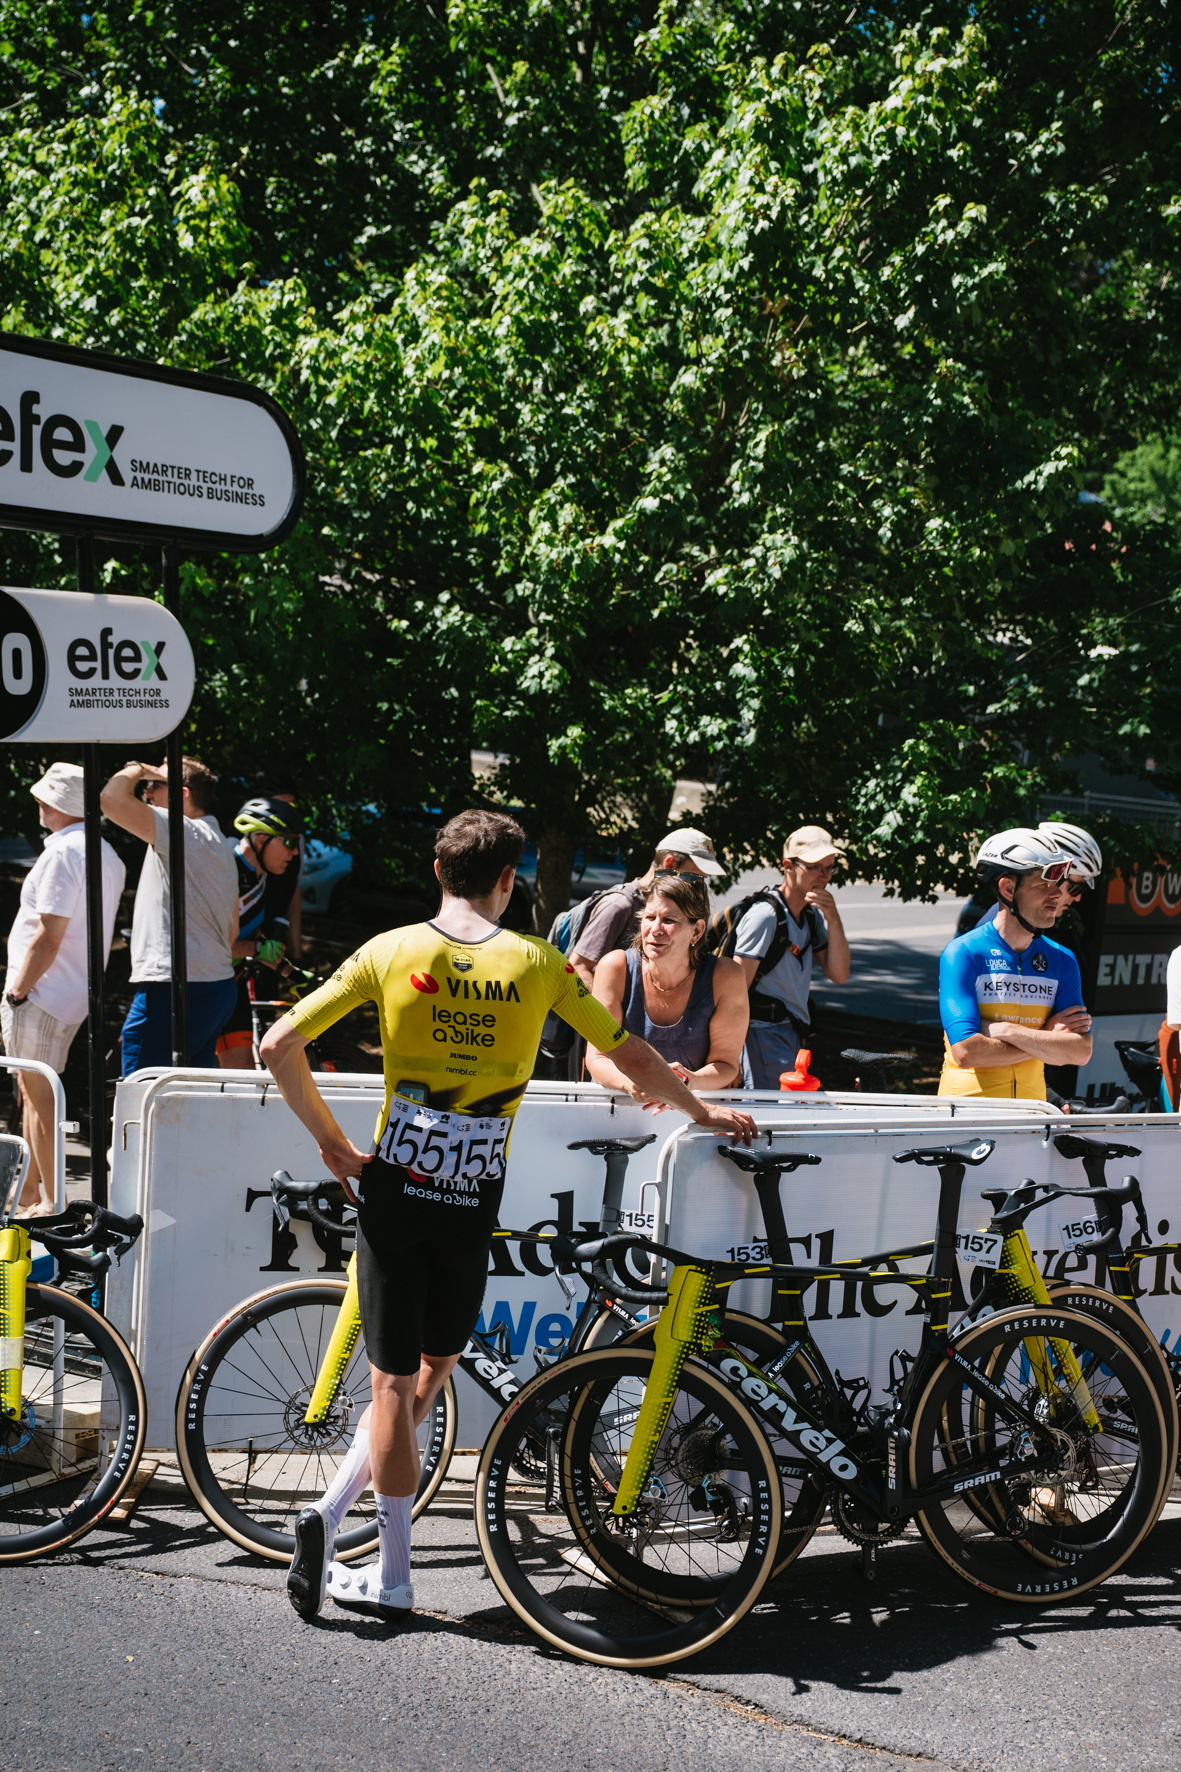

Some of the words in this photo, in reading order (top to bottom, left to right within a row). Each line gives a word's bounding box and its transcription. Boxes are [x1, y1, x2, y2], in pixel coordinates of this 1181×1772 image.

[130, 459, 192, 481] SMARTER
[195, 469, 227, 486] TECH
[230, 475, 254, 490] FOR
[130, 476, 203, 498] AMBITIOUS
[206, 487, 265, 507] BUSINESS
[67, 627, 168, 681] efex
[68, 687, 114, 697] SMARTER
[117, 688, 141, 697] TECH
[143, 688, 161, 698] FOR
[69, 699, 124, 708] AMBITIOUS
[126, 699, 169, 708] BUSINESS
[446, 977, 520, 1003] VISMA
[984, 981, 1053, 996] KEYSTONE
[432, 1004, 496, 1028] lease
[994, 1013, 1042, 1024] Lawrence
[449, 1052, 478, 1062] JUMBO
[446, 1066, 477, 1077] nimbl.cc
[386, 1117, 449, 1175] 155
[403, 1183, 441, 1202] lease
[625, 1212, 654, 1229] 155
[1062, 1219, 1095, 1239] 156
[726, 1244, 765, 1262] 153
[961, 1233, 998, 1254] 157
[1067, 1296, 1114, 1314] RESERVE
[1004, 1318, 1066, 1333] RESERVE
[954, 1352, 972, 1372] VISMA
[188, 1363, 209, 1430] RESERVE
[719, 1357, 858, 1480] cervélo
[113, 1414, 136, 1479] RESERVE
[425, 1406, 444, 1472] RESERVE
[888, 1437, 896, 1490] SRAM
[953, 1471, 1001, 1493] SRAM
[487, 1458, 502, 1533] RESERVE
[574, 1468, 598, 1535] RESERVE
[754, 1480, 769, 1556] RESERVE
[1016, 1576, 1078, 1593] RESERVE
